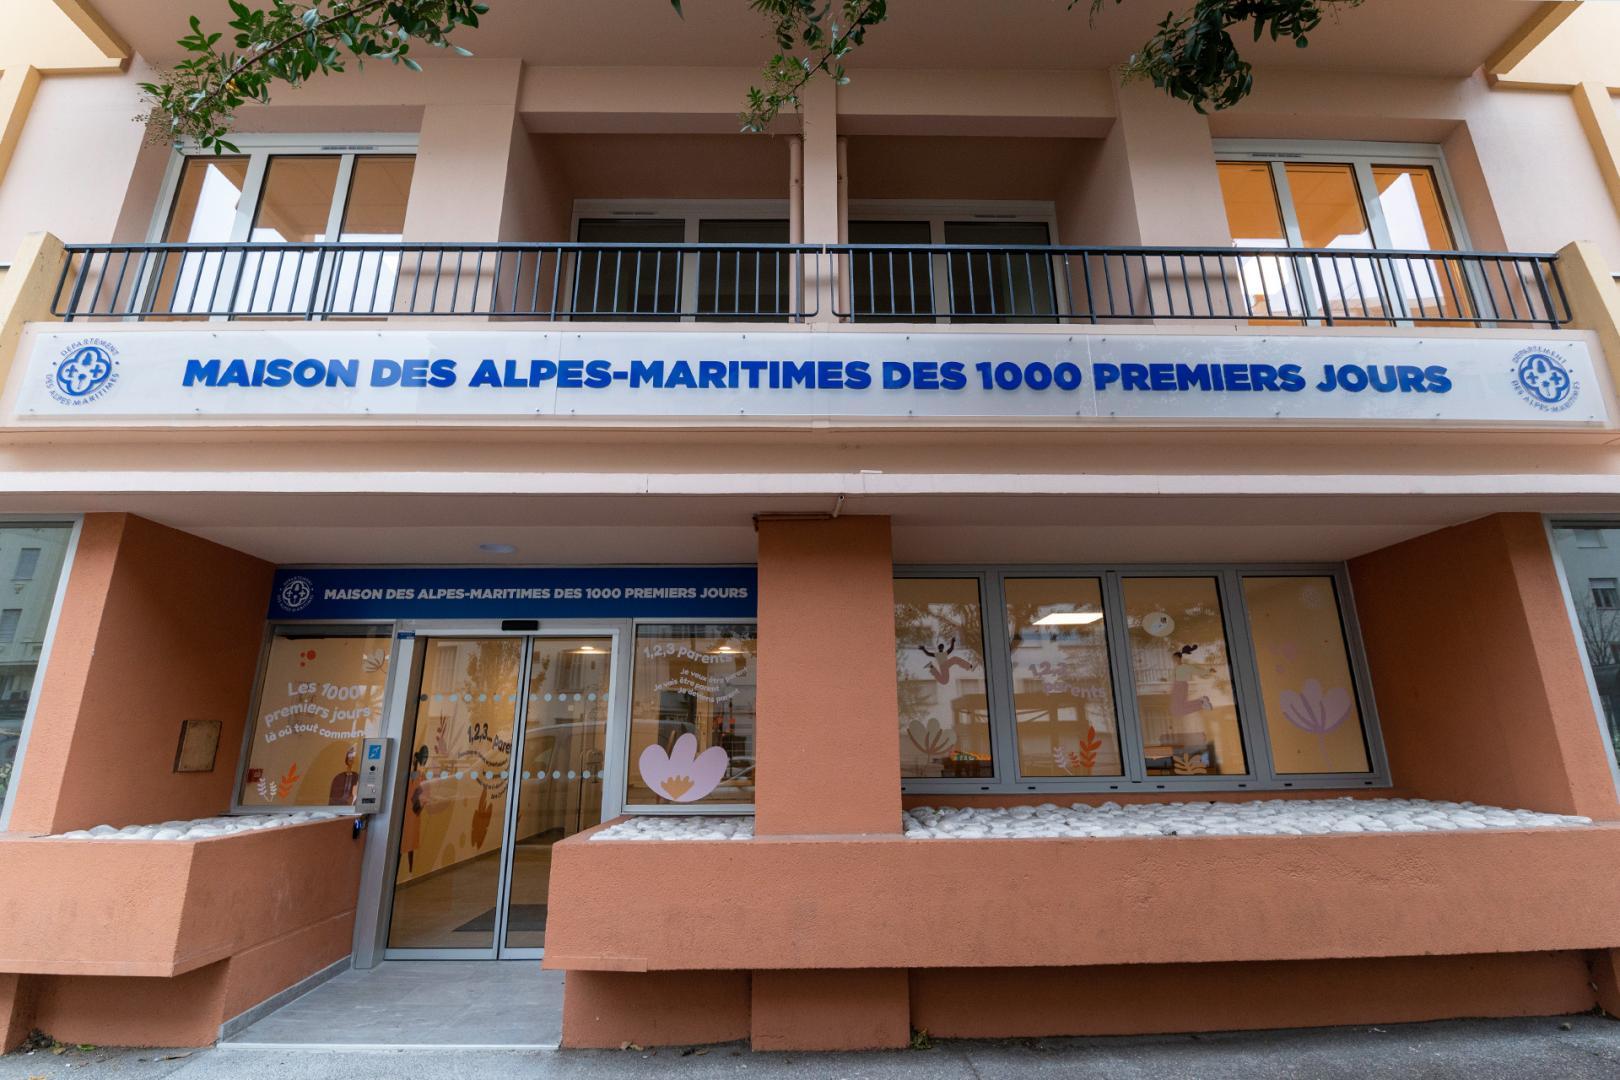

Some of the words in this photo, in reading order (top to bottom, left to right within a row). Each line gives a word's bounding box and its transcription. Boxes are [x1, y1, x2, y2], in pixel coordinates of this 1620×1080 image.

[182, 358, 358, 388] MAISON
[370, 358, 456, 389] DES
[468, 358, 872, 390] ALPES-MARITIMES
[881, 360, 968, 391] DES
[975, 361, 1083, 391] 1000
[1092, 362, 1307, 393] PREMIERS
[1316, 363, 1453, 394] JOURS
[324, 588, 383, 600] MAISON
[385, 588, 415, 600] DES
[417, 588, 551, 600] ALPES-MARITIMES
[554, 588, 582, 599] DES
[585, 587, 622, 599] 1000
[624, 587, 697, 599] PREMIERS
[700, 587, 748, 598] JOURS
[644, 643, 675, 659] 1,2,3
[677, 645, 733, 664] parents
[691, 671, 707, 682] veux
[287, 682, 317, 697] Les
[322, 683, 361, 700] 1000
[694, 683, 720, 693] parent
[1044, 682, 1105, 698] parents
[264, 699, 330, 727] premiers
[329, 706, 371, 724] jours
[294, 723, 319, 733] tout
